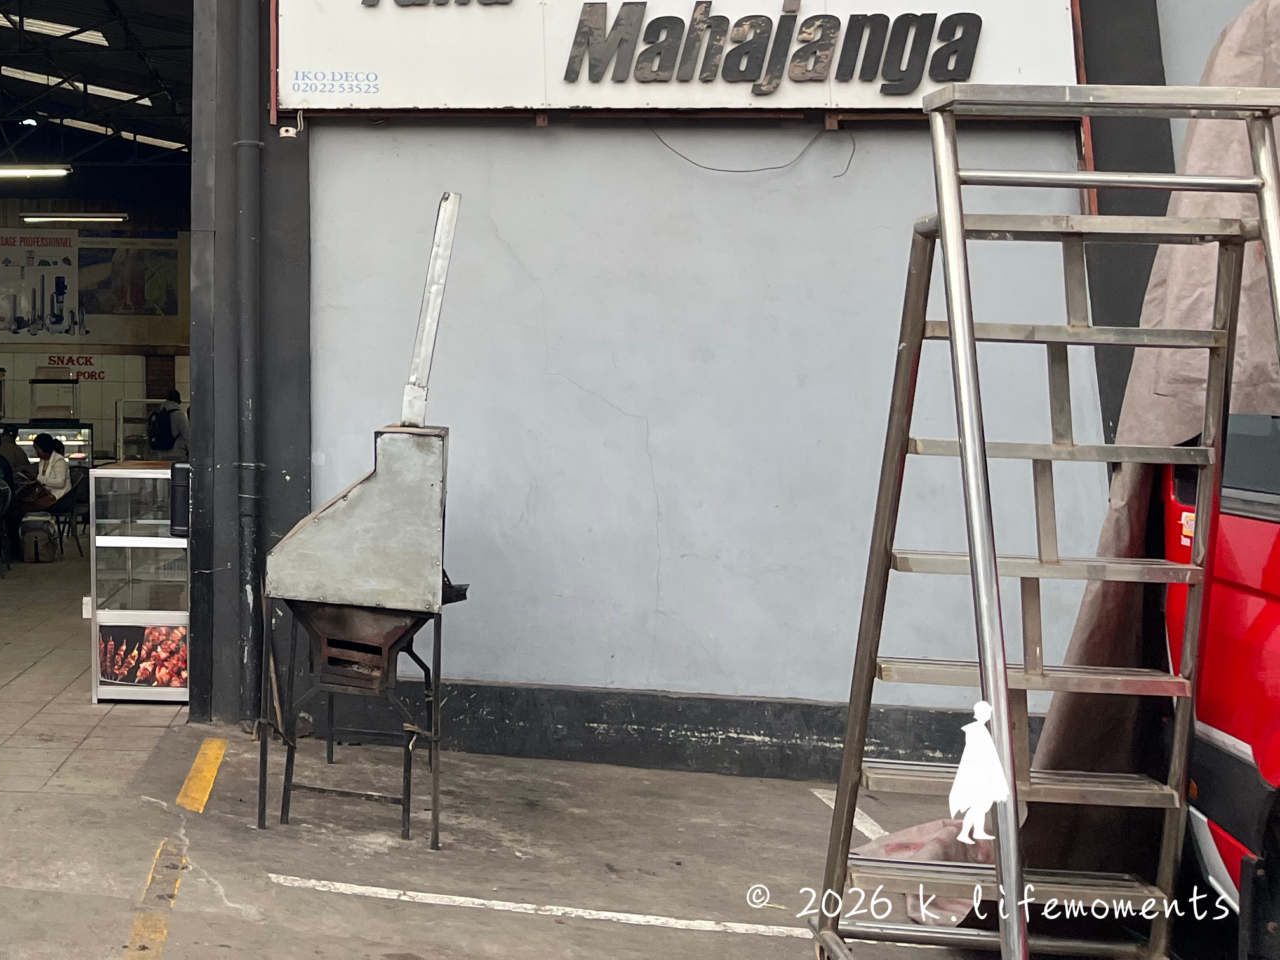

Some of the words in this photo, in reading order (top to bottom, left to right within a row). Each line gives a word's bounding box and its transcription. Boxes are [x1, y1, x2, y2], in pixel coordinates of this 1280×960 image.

[19, 236, 73, 248] PROFESSIONNEL
[48, 355, 95, 366] SNACK
[75, 371, 106, 380] PORC
